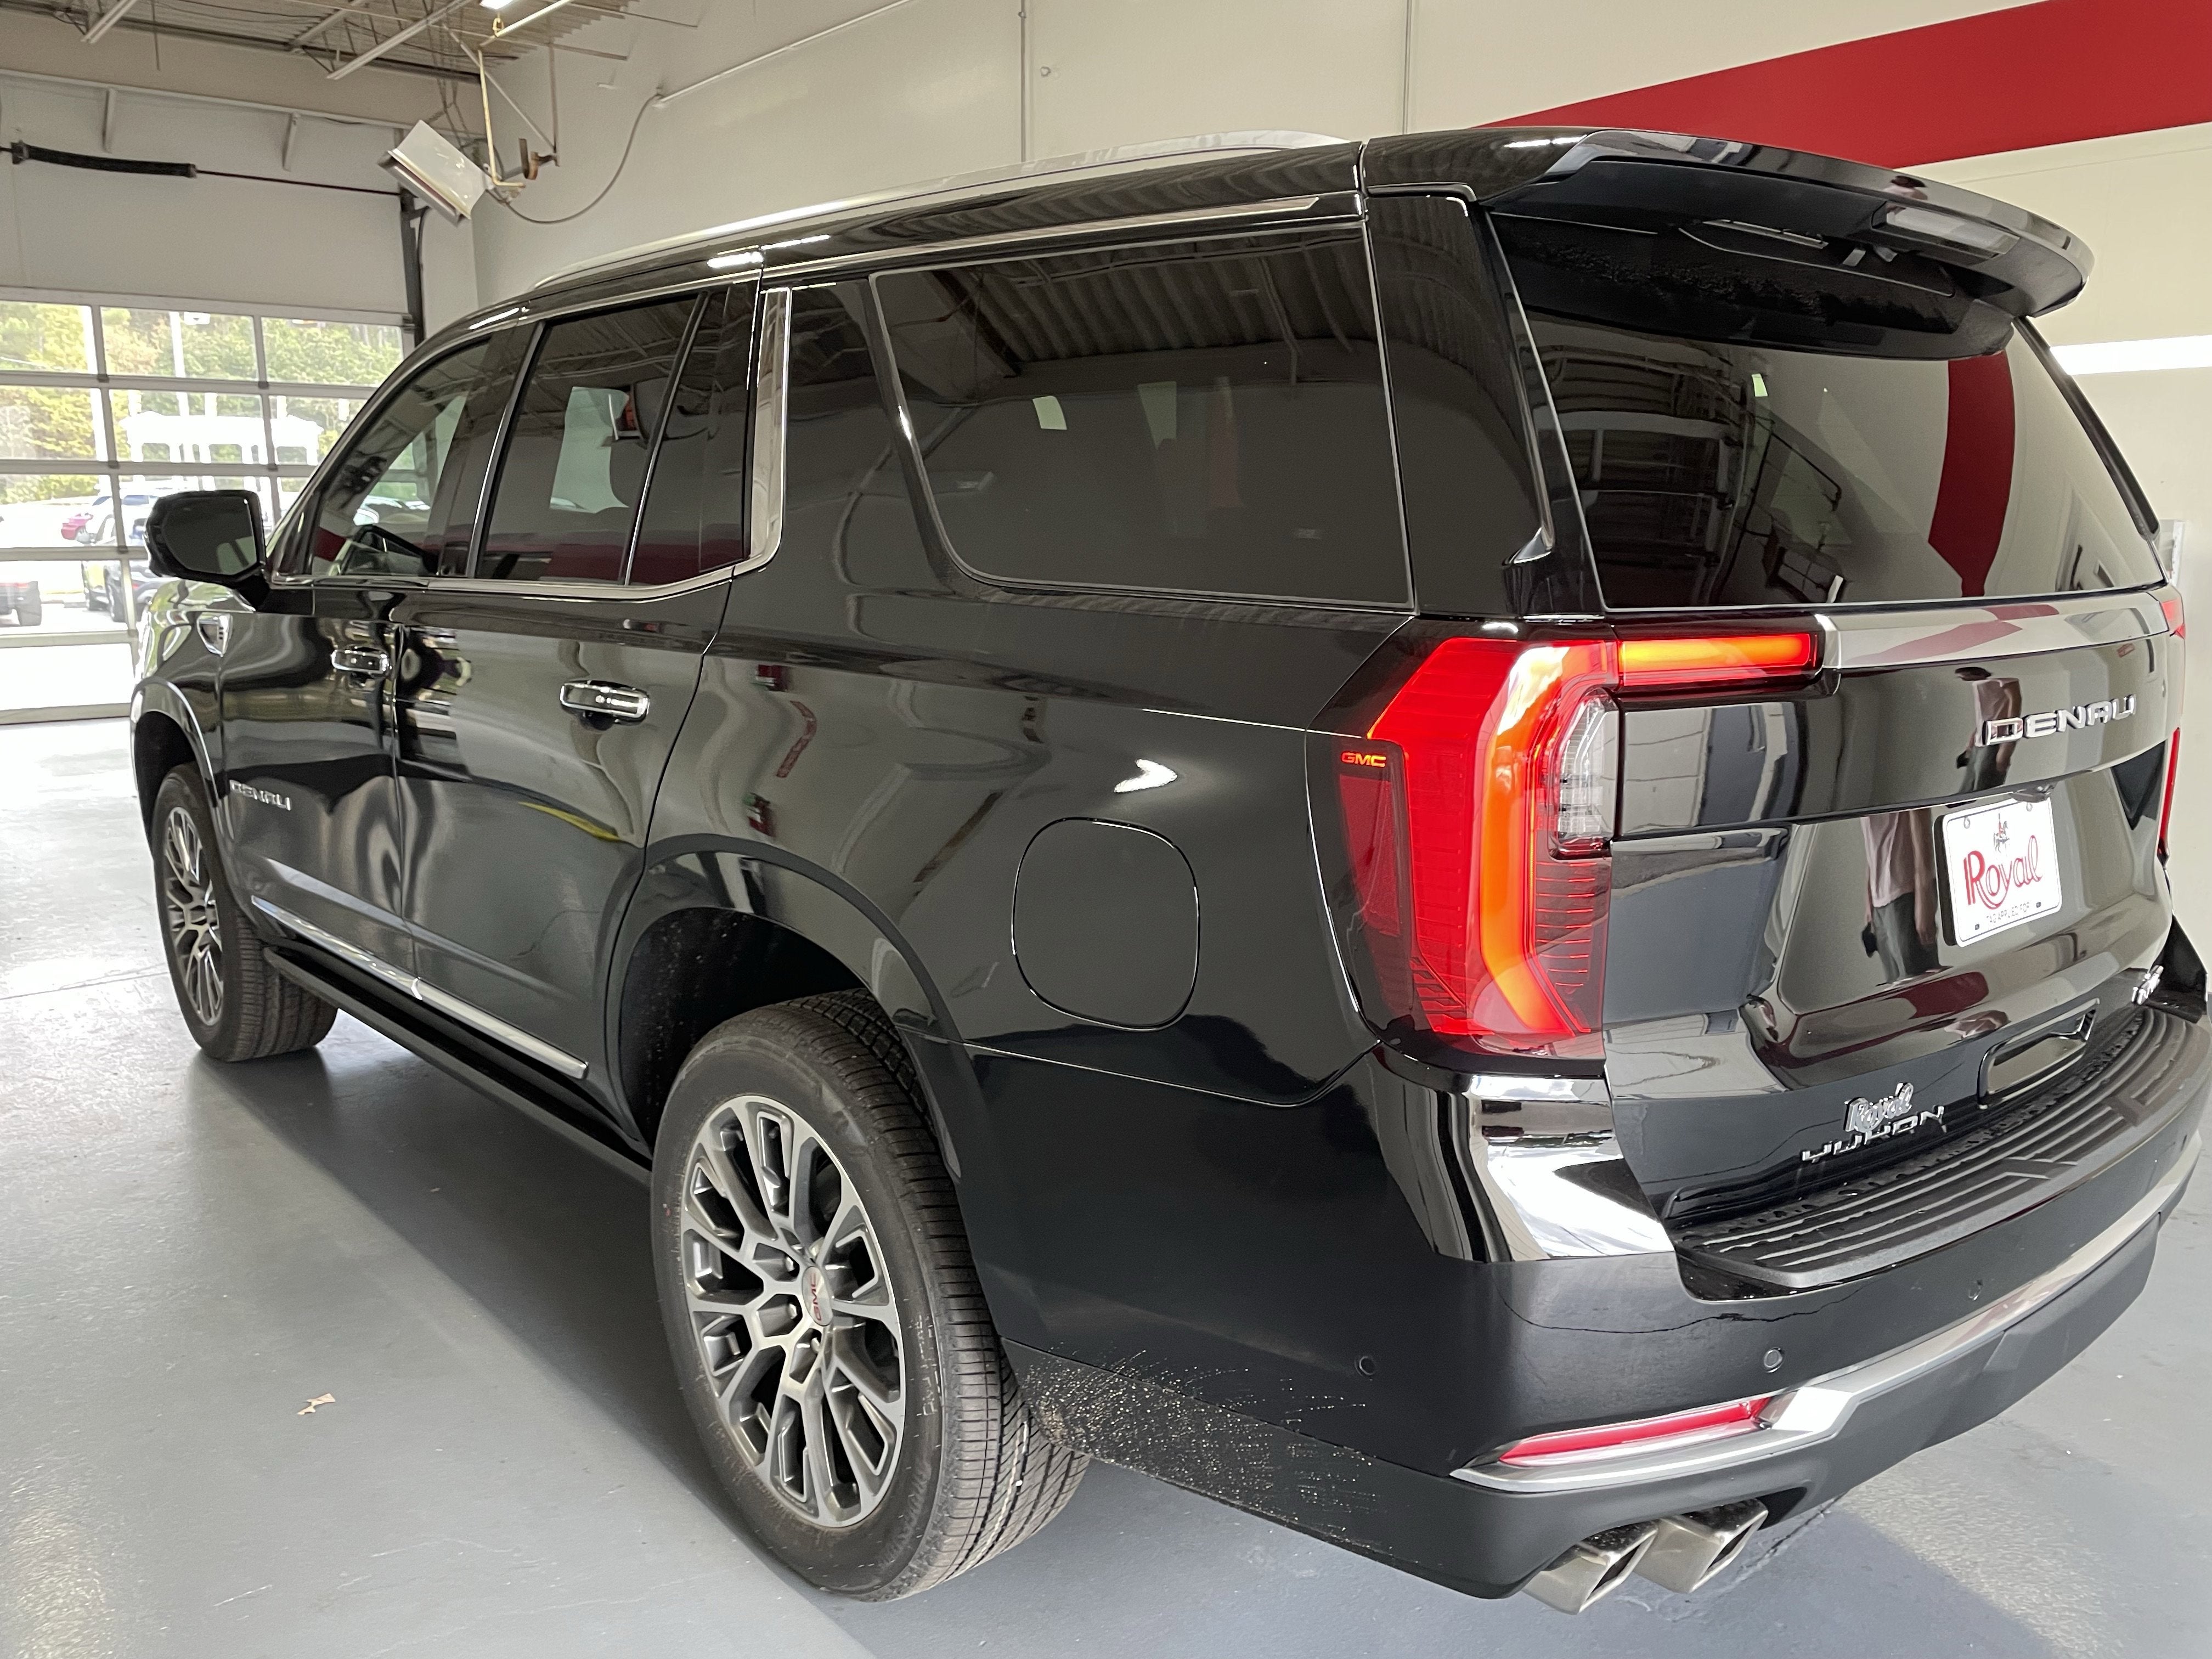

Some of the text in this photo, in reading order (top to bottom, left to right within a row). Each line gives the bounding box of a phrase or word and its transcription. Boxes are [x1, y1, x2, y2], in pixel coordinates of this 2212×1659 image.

[1982, 694, 2136, 745] DENALI
[1341, 752, 1386, 768] GMC
[229, 779, 291, 811] DENALI
[1963, 835, 2042, 910] Royal
[1844, 1082, 1914, 1133] Royal
[1802, 1105, 1948, 1164] YUKON
[809, 1272, 822, 1321] GMC
